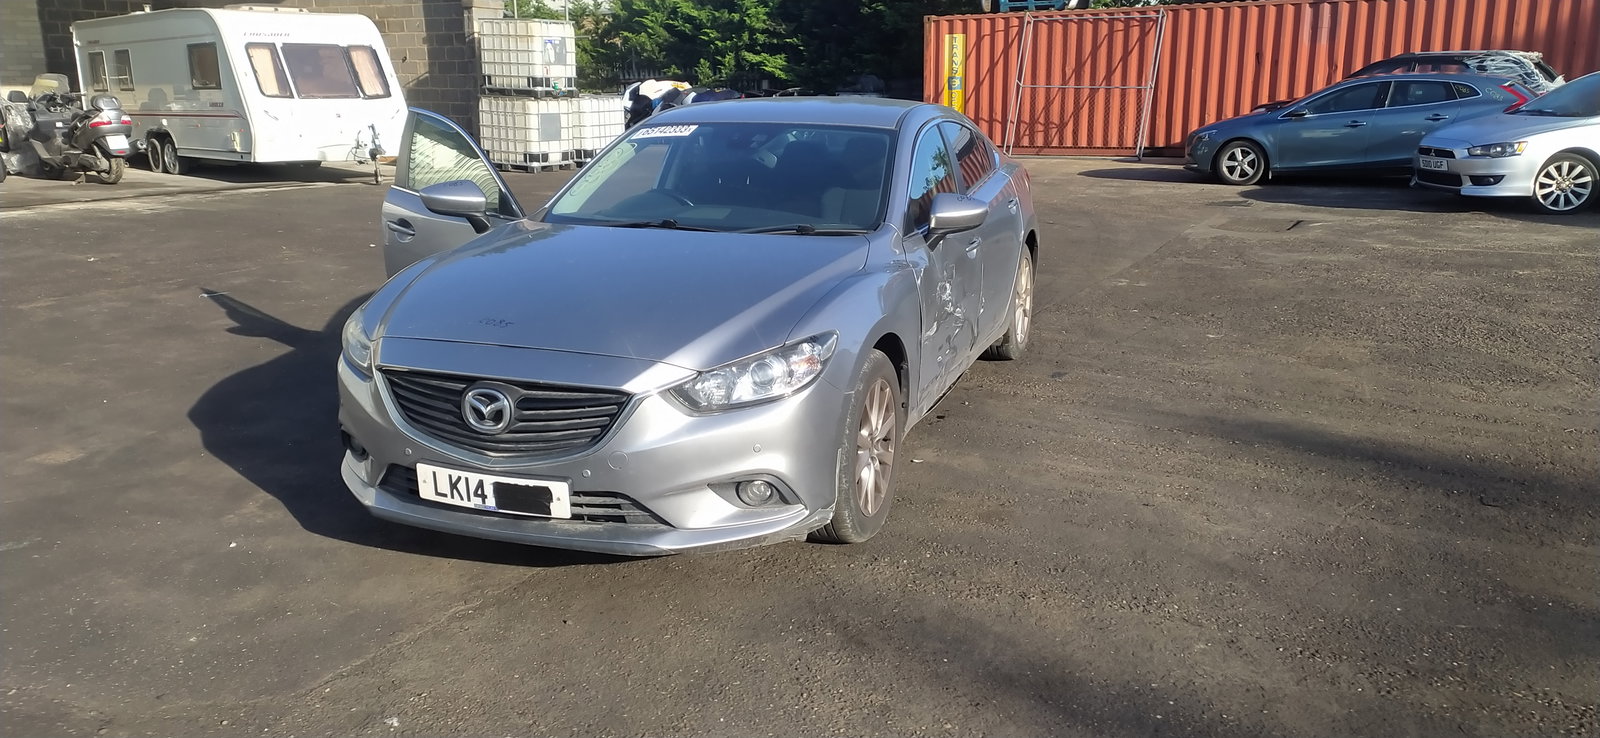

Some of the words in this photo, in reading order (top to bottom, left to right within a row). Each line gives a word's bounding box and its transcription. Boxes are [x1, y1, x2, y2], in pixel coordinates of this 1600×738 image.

[951, 36, 959, 75] TRANS
[1432, 160, 1444, 169] UGF
[431, 470, 488, 505] LK14
